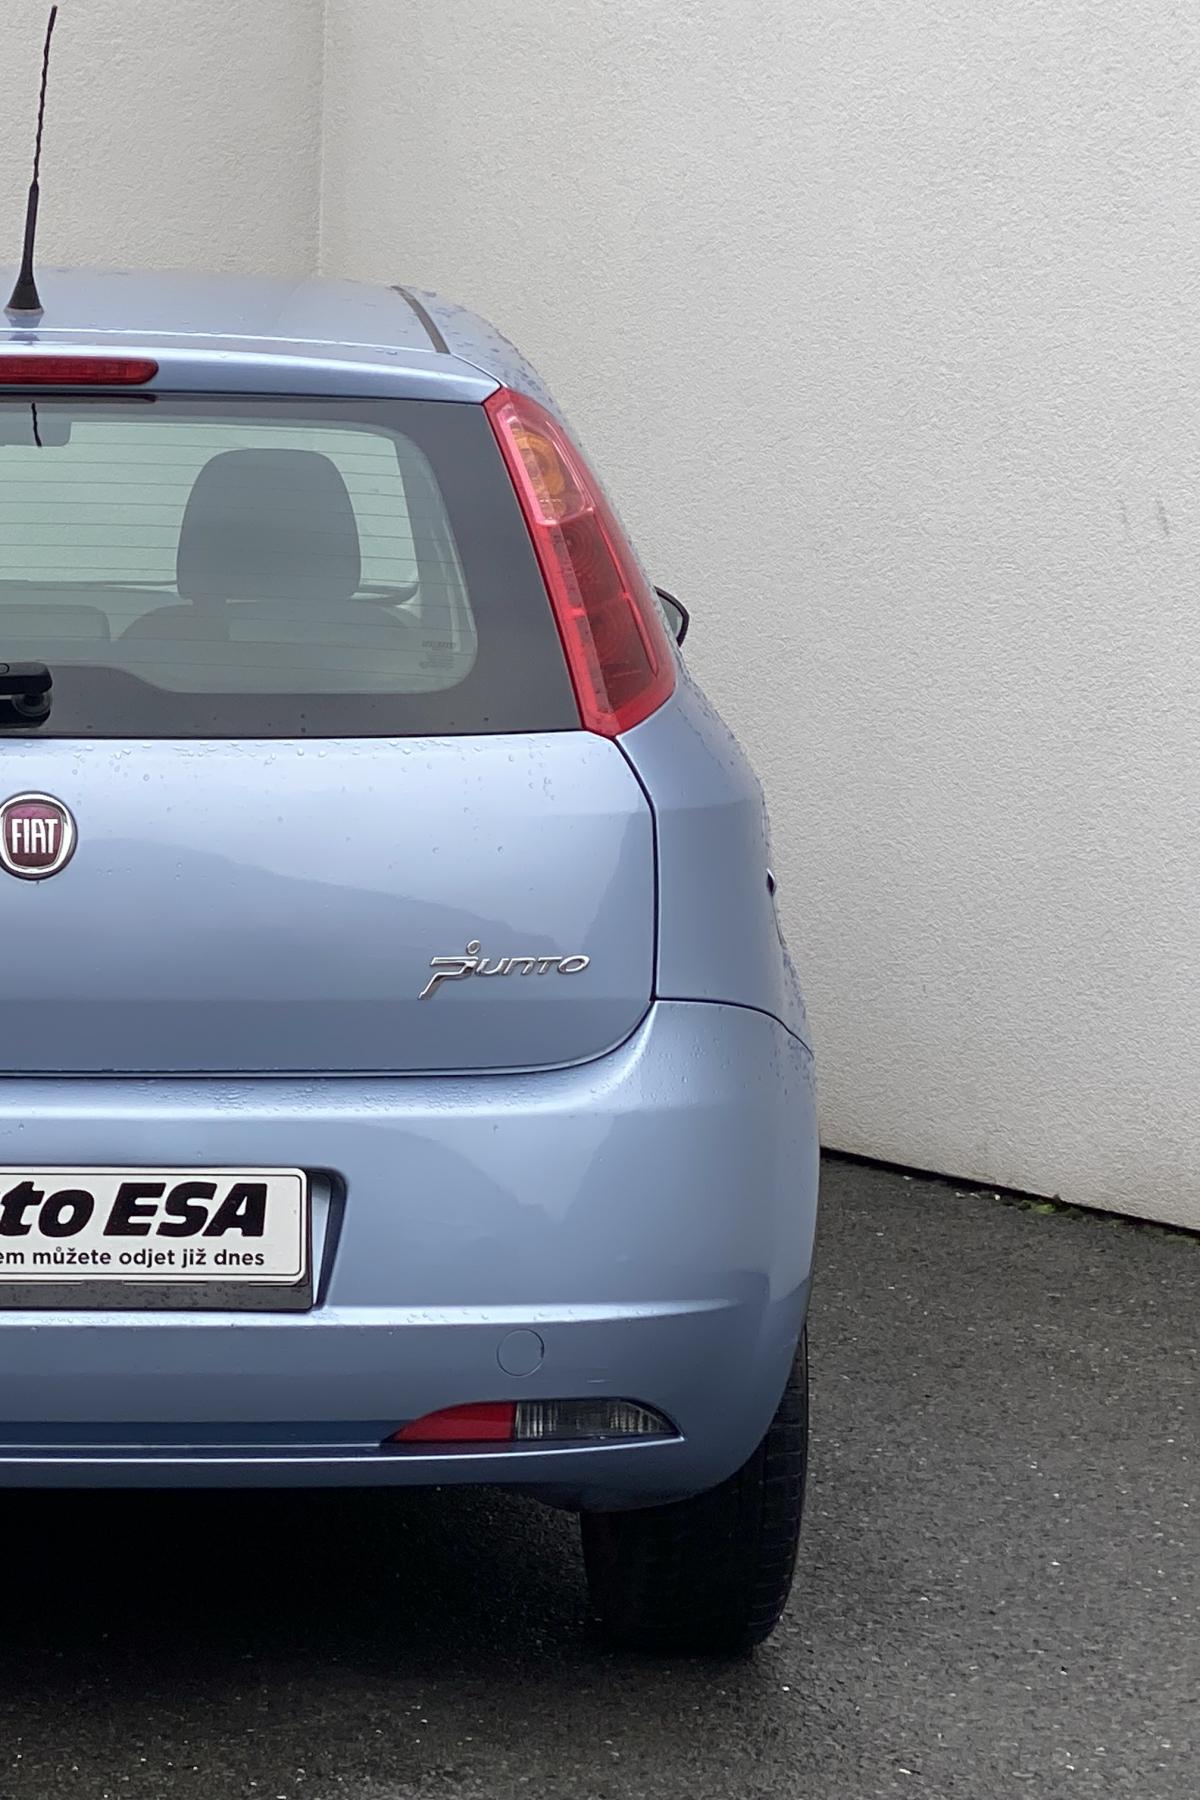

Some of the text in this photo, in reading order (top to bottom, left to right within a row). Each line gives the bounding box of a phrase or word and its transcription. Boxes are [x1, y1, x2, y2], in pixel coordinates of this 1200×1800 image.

[11, 818, 59, 854] FIAT
[102, 1181, 268, 1238] ESA
[32, 1246, 112, 1265] můžete
[118, 1248, 176, 1268] odjet
[181, 1248, 207, 1269] již
[213, 1248, 265, 1266] dnes
